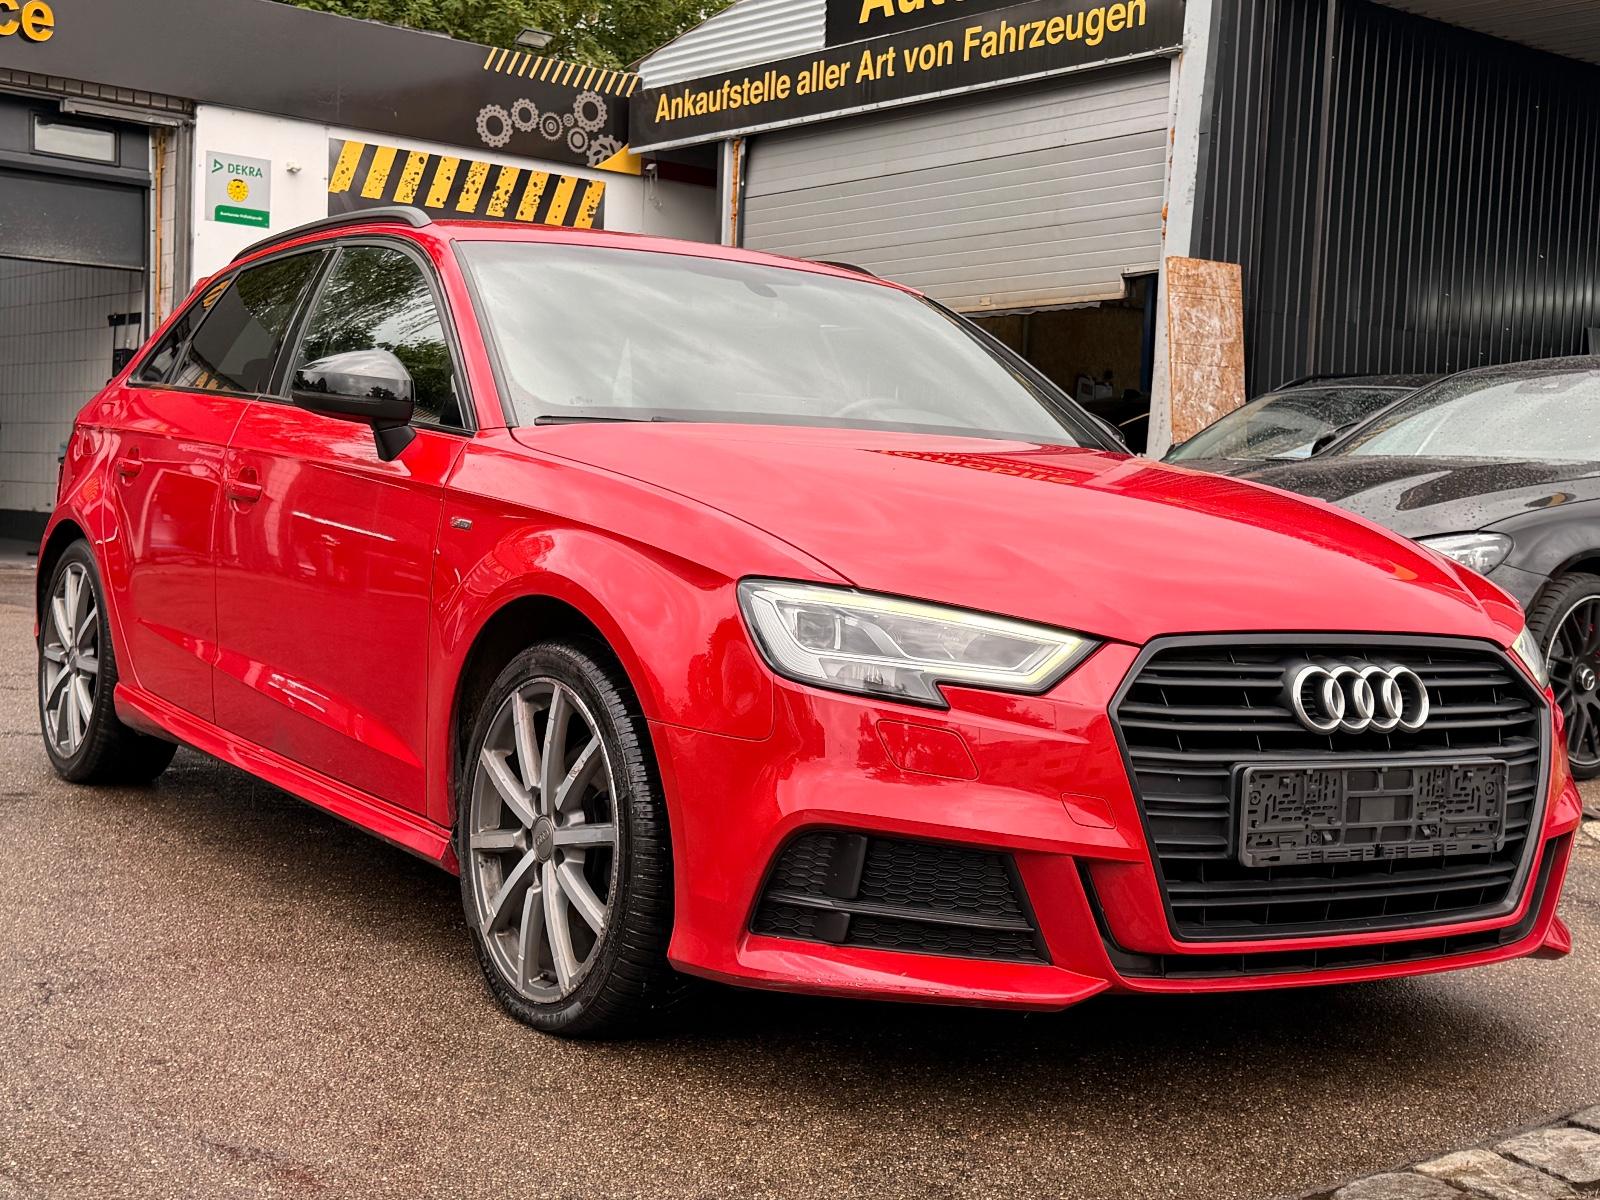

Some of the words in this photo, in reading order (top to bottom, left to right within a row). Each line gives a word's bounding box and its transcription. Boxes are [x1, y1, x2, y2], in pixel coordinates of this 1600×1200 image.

[655, 70, 791, 123] Ankaufstelle
[797, 60, 850, 96] aller
[856, 46, 896, 83] Art
[904, 40, 954, 73] von
[963, 0, 1147, 62] Fahrzeugen
[227, 163, 263, 178] DEKRA
